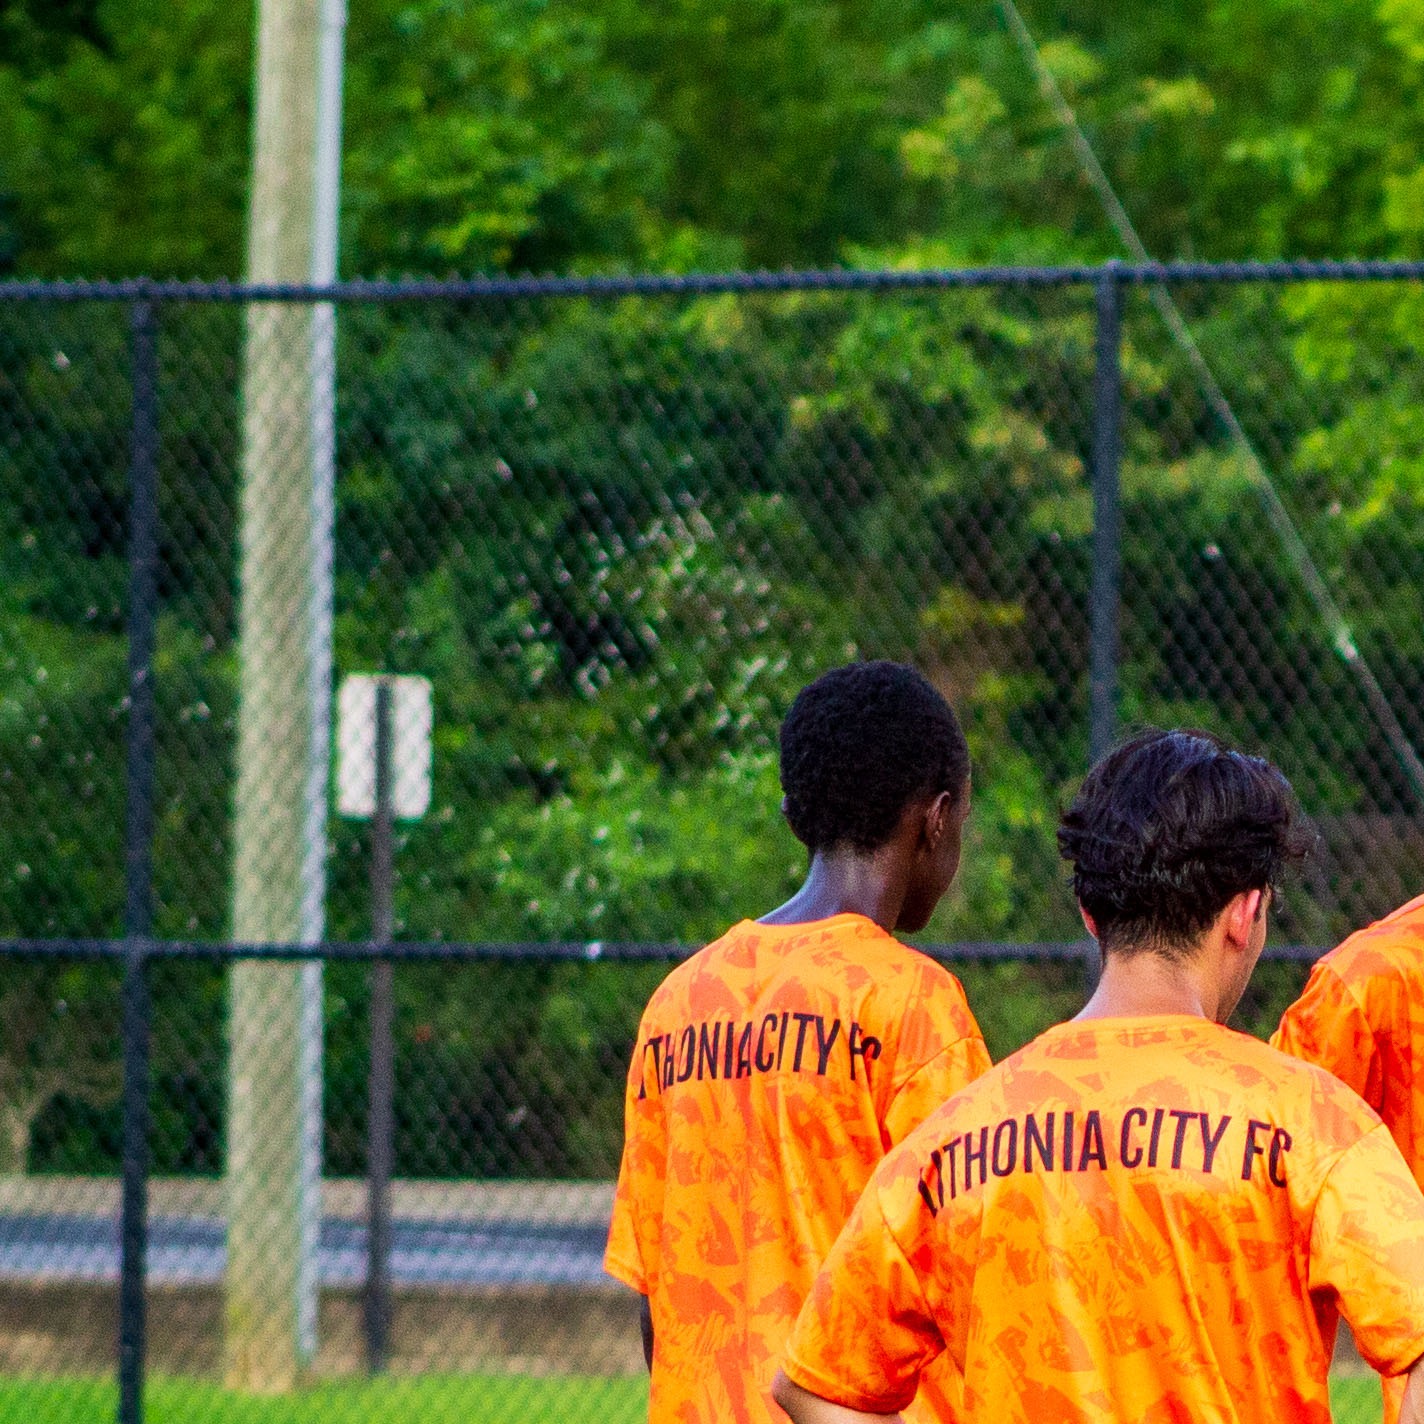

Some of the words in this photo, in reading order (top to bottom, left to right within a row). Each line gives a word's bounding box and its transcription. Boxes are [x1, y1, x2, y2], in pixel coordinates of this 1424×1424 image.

[755, 1011, 841, 1075] CITY
[1119, 1106, 1232, 1174] CITY
[1240, 1118, 1293, 1189] FC
